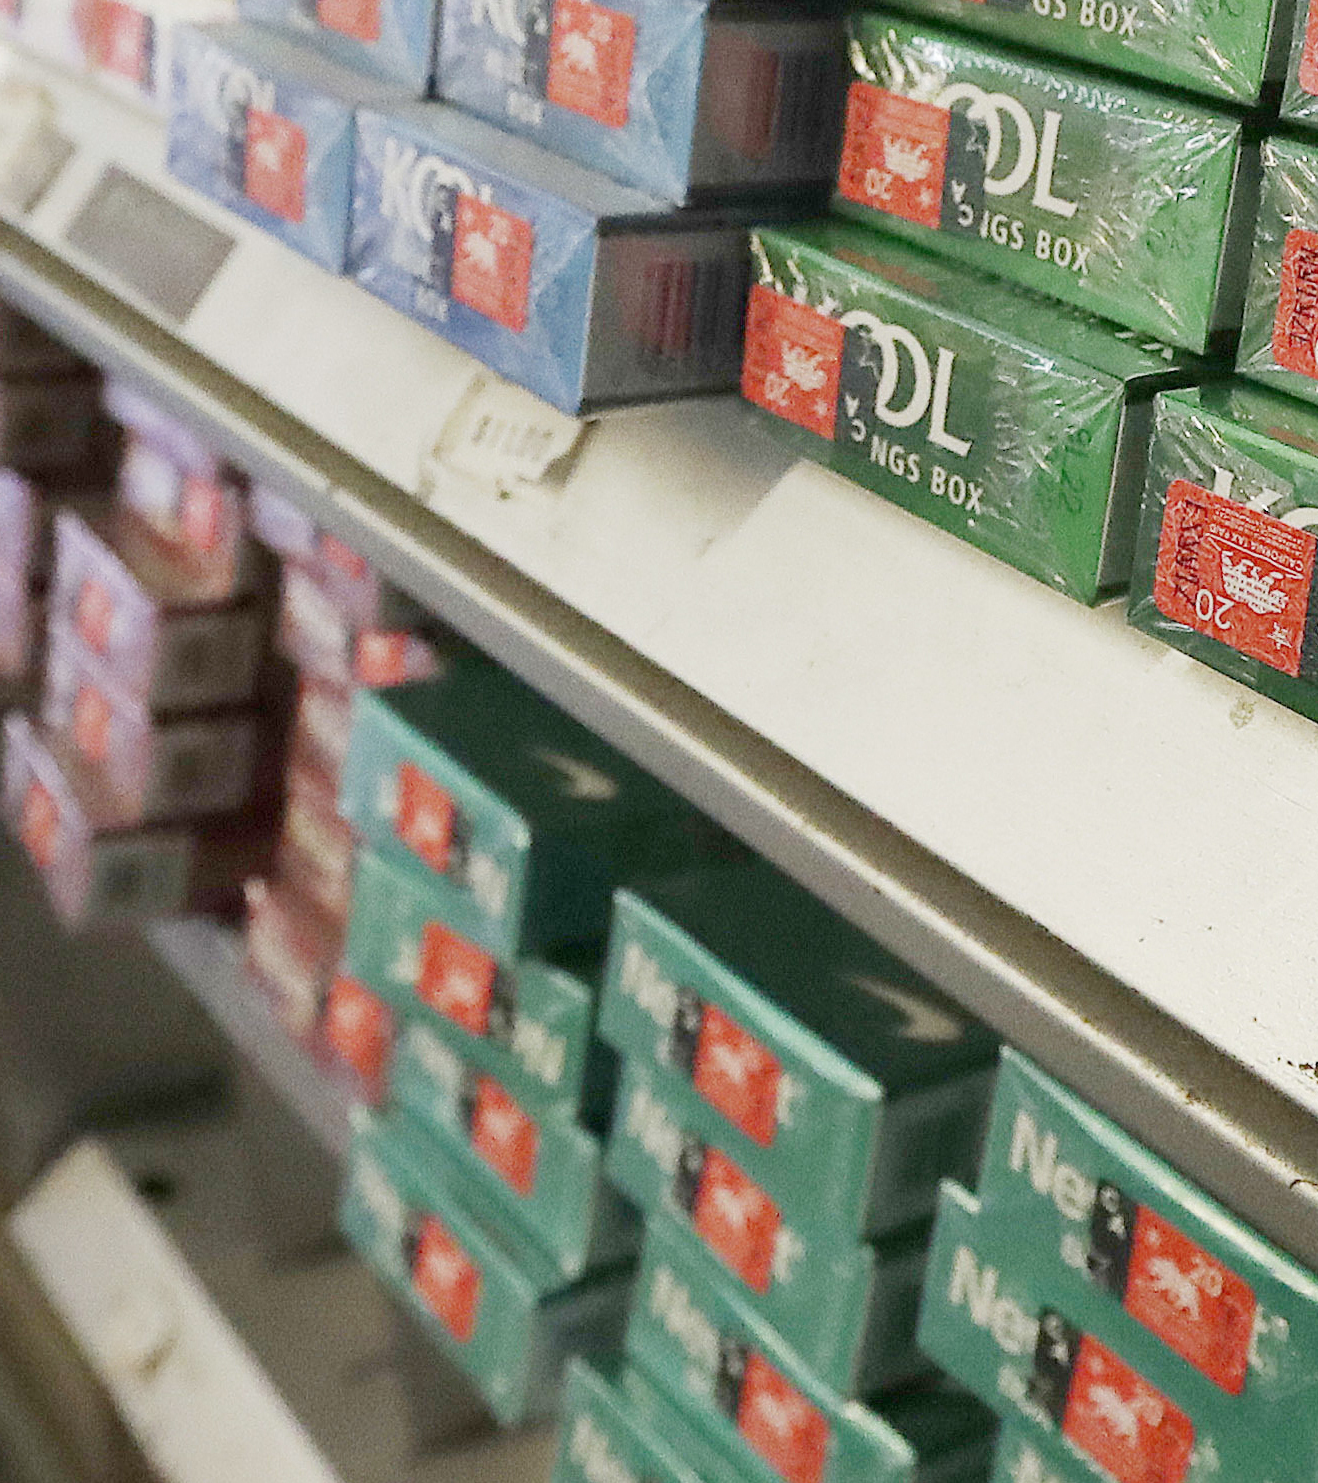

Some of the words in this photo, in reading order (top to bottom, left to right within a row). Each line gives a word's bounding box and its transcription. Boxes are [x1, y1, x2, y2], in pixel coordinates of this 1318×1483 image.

[1034, 229, 1091, 275] BOX
[930, 467, 985, 516] BOX
[1231, 534, 1250, 551] TAX
[1251, 540, 1304, 572] CALIFORNIA
[1195, 588, 1235, 630] 20
